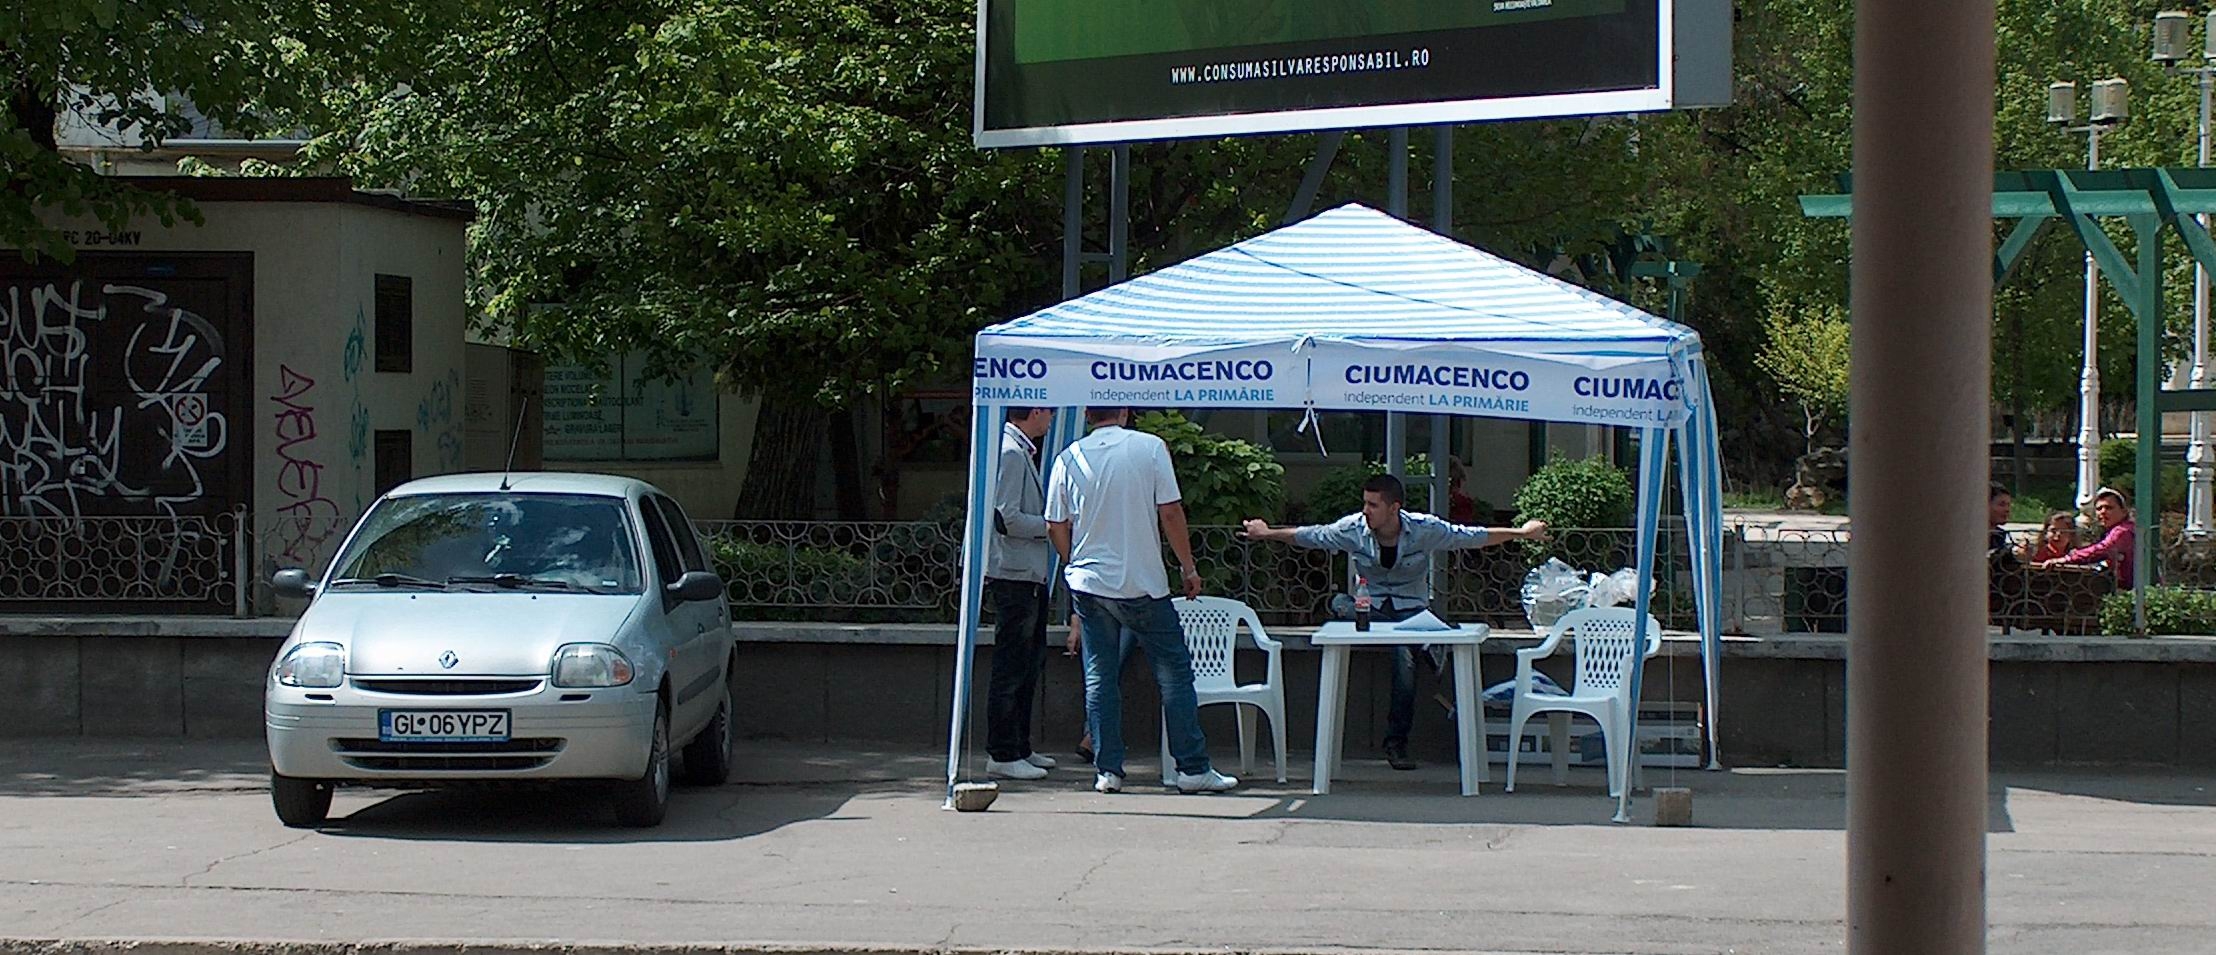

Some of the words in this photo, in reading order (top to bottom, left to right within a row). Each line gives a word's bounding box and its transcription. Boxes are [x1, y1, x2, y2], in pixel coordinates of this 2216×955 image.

[1171, 49, 1430, 83] WWW.CONSUMASILVARESPONSABIL.RO
[1091, 360, 1273, 381] CIUMACENCO
[1345, 364, 1530, 391] CIUMACENCO
[1091, 389, 1170, 402] independent
[1175, 389, 1194, 400] LA
[1199, 387, 1274, 400] PRIMĂRIE
[1344, 391, 1425, 405] independent
[1429, 394, 1449, 406] LA
[1453, 395, 1529, 412] PRIMĂRIE
[1573, 404, 1653, 420] independent
[394, 714, 422, 735] GL
